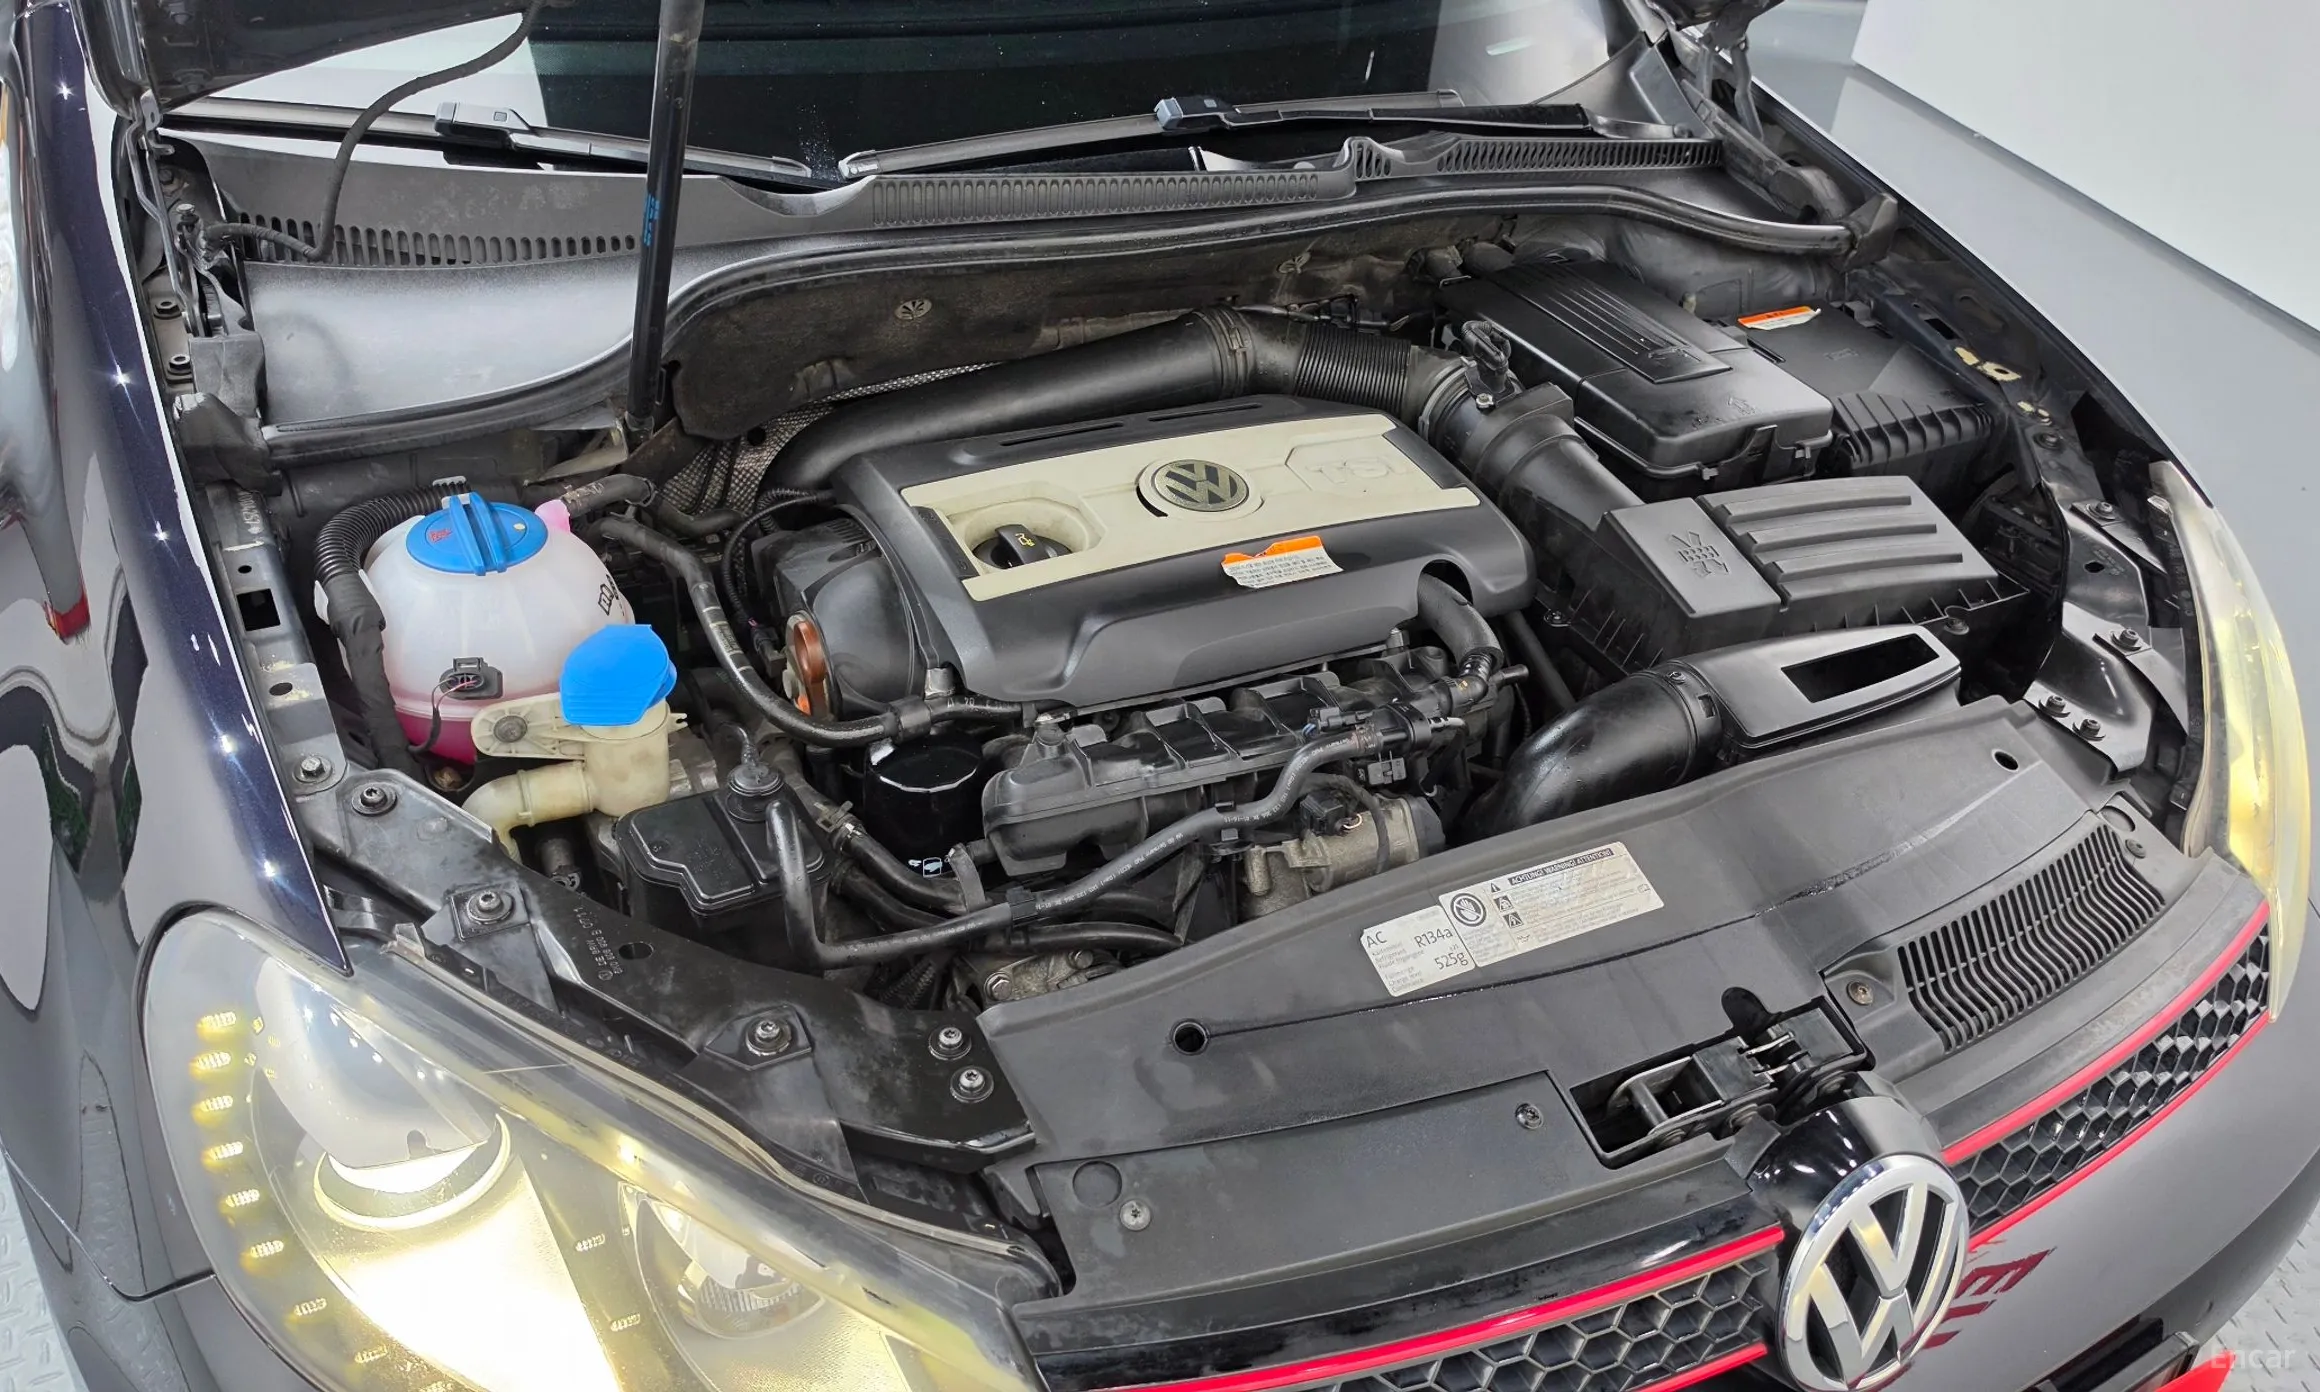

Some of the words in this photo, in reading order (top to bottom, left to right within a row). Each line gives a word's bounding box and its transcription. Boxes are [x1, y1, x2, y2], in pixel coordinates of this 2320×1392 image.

[1511, 867, 1544, 885] ACHTUNG!
[1544, 859, 1576, 876] WARNING!
[1576, 848, 1612, 867] ATTENTION!
[1366, 931, 1387, 948] AC
[1413, 928, 1454, 948] R134a
[1434, 952, 1469, 970] 525g
